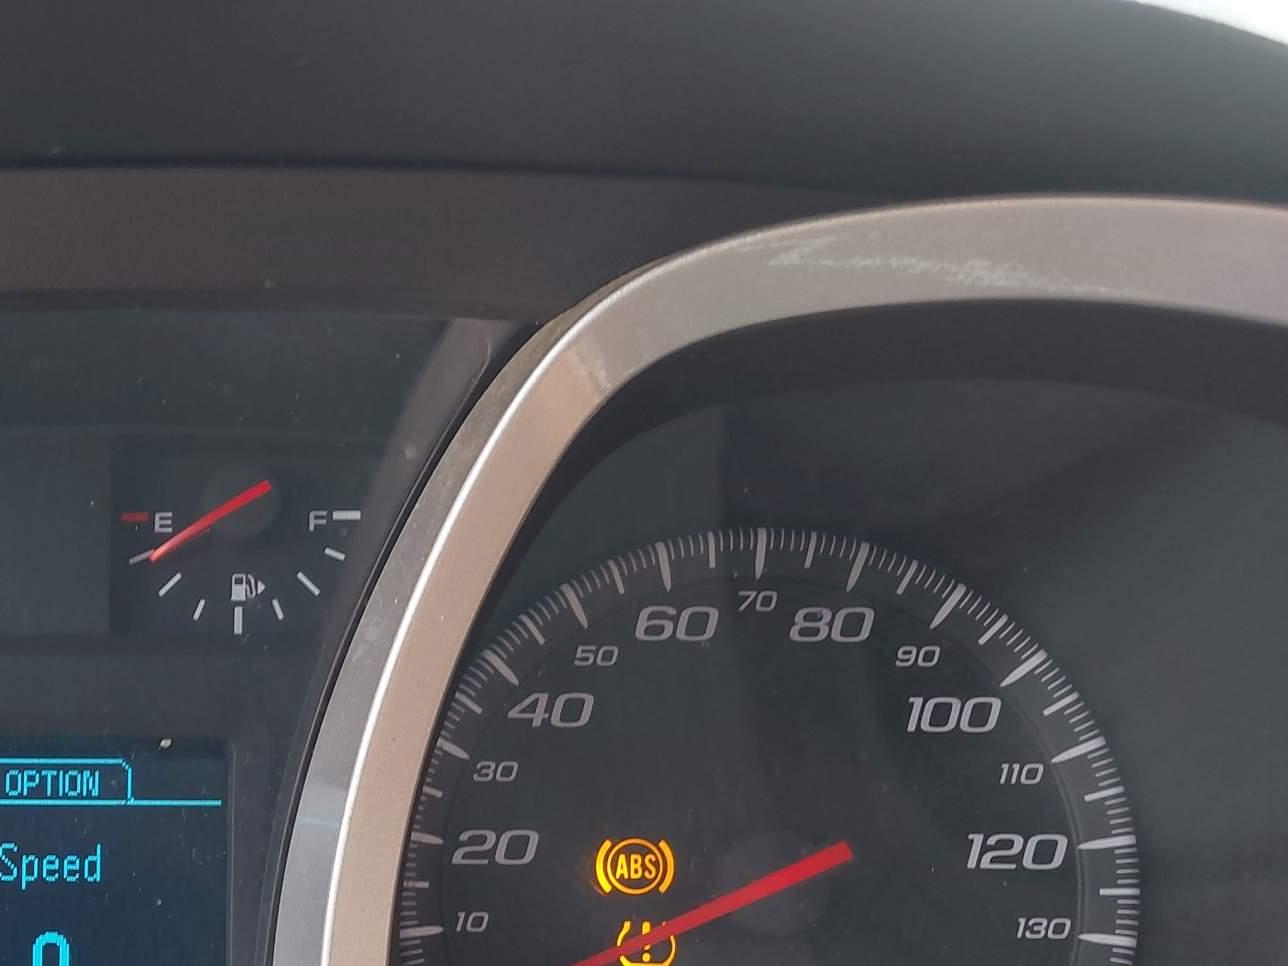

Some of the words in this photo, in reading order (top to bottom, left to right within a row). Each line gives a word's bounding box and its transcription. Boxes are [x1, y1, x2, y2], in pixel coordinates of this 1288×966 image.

[154, 512, 173, 533] E
[309, 510, 328, 531] F
[737, 590, 777, 613] 70
[634, 606, 719, 642] 60
[788, 607, 874, 643] 80
[574, 645, 619, 667] 50
[895, 645, 940, 667] 90
[507, 692, 594, 728] 40
[906, 696, 1002, 733] 100
[472, 760, 518, 782] 30
[998, 761, 1044, 785] 110
[5, 770, 100, 797] OPTION
[451, 830, 539, 865] 20
[965, 833, 1069, 869] 120
[615, 852, 657, 881] ABS
[454, 911, 489, 933] 10
[1015, 918, 1072, 940] 130
